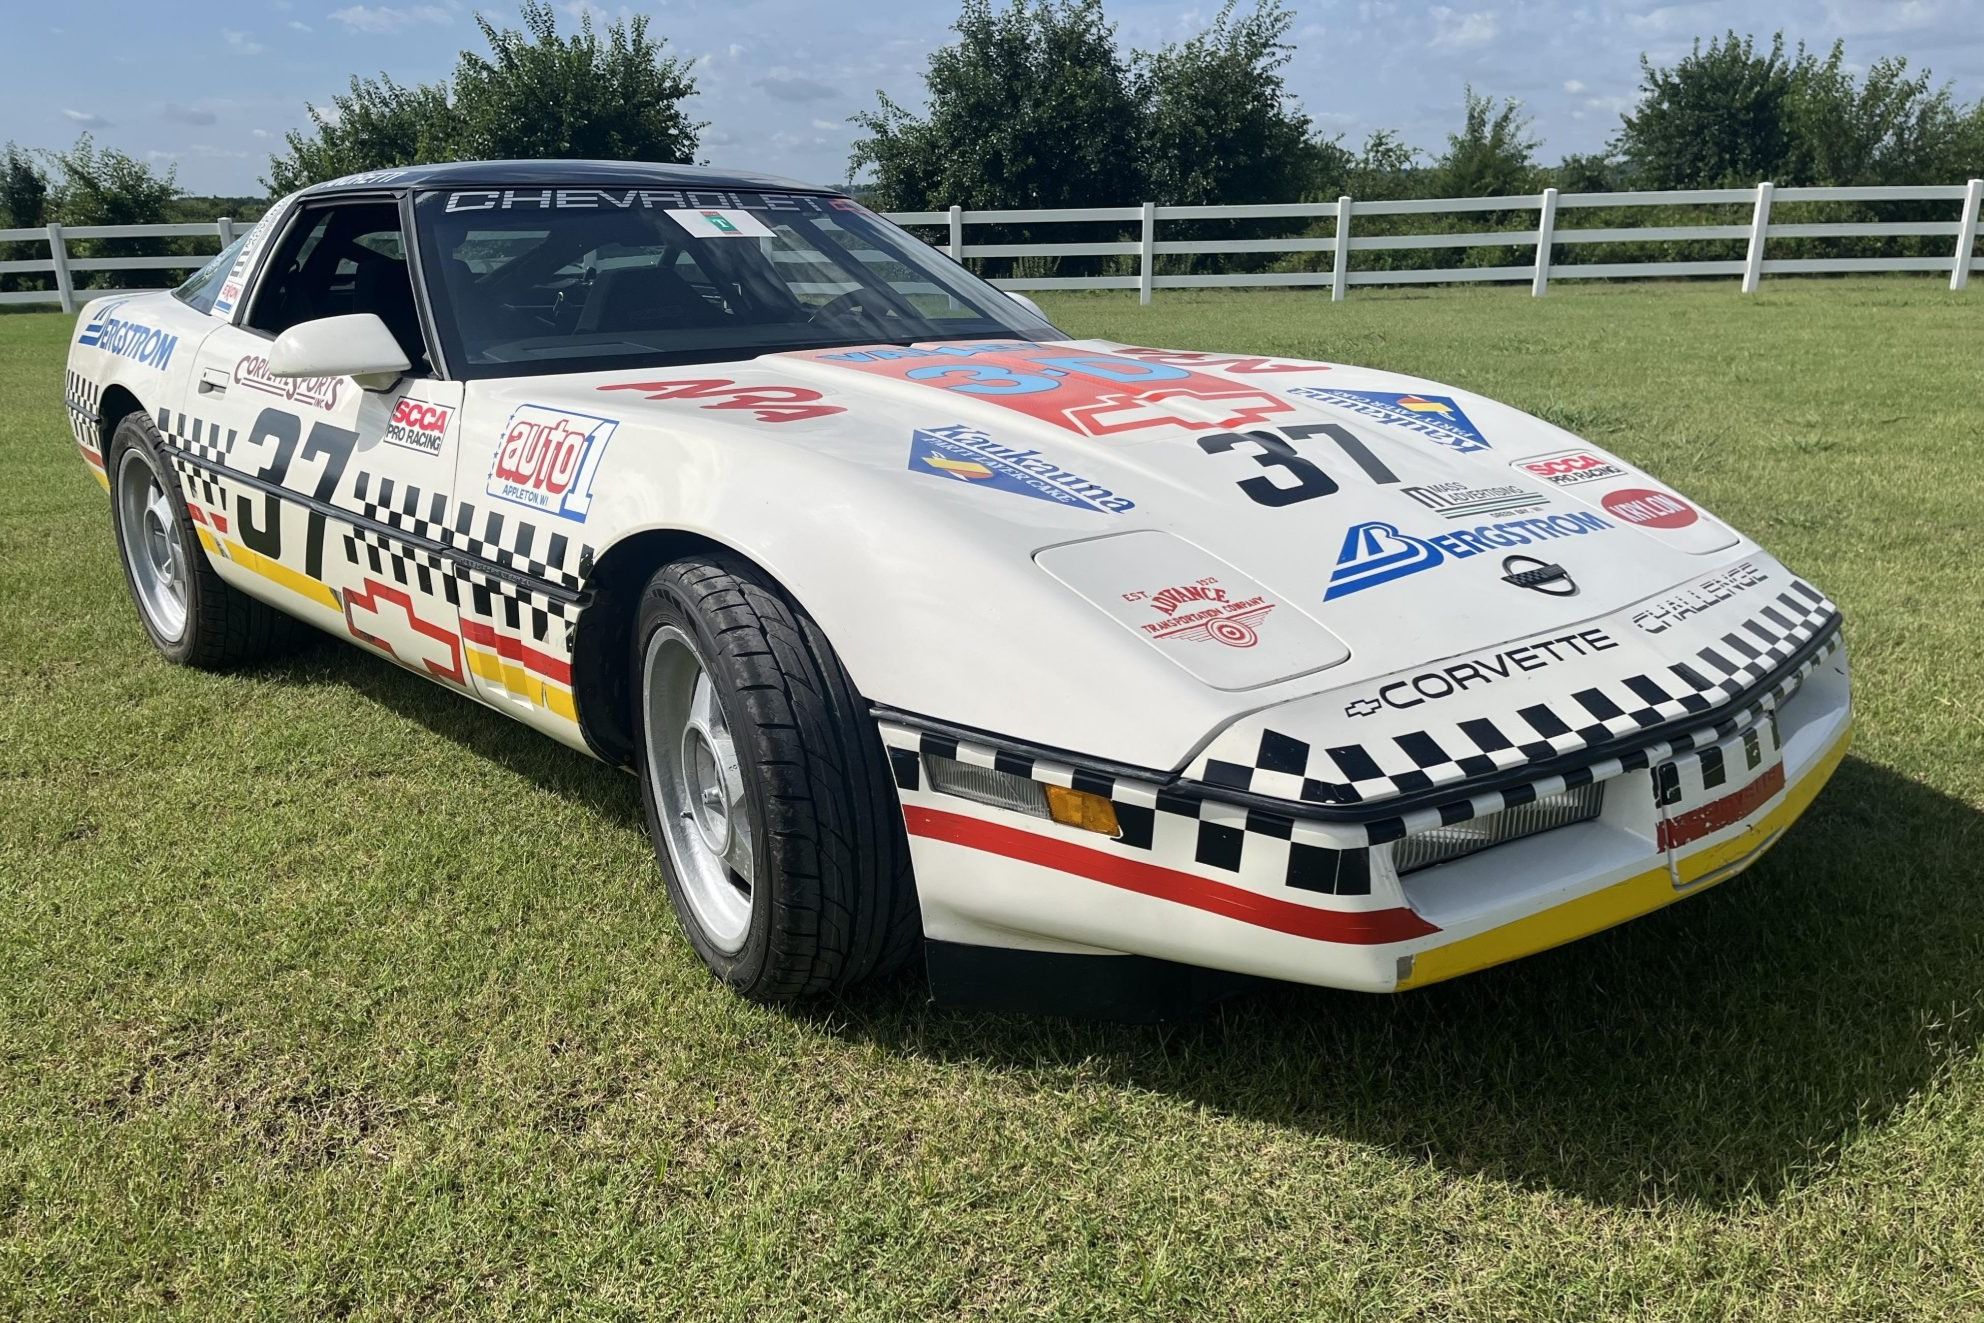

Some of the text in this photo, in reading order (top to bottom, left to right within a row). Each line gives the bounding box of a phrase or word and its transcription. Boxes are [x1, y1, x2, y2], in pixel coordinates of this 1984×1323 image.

[445, 189, 823, 213] CHEVROLET
[78, 300, 180, 371] BERGSTROM
[391, 400, 448, 434] SCCA
[1285, 387, 1486, 455] Kaukauna
[386, 424, 441, 451] PRO RACING
[496, 419, 586, 494] auto
[919, 423, 1137, 514] Kaukauna
[1196, 423, 1401, 508] 37
[1524, 454, 1608, 477] SCCA
[1026, 478, 1079, 503] CAKE
[1426, 481, 1468, 493] MASS
[1546, 464, 1623, 485] PRO RACING
[237, 407, 359, 581] 37
[1447, 485, 1525, 502] ADVERTISING
[1608, 494, 1687, 523] KRYLON
[1322, 511, 1615, 602] BERGSTROM
[1140, 595, 1266, 634] TRANSPORTATION COMPANY
[1150, 585, 1230, 616] ADVANCE
[1378, 561, 1770, 709] CORVETTE CHALLENGE
